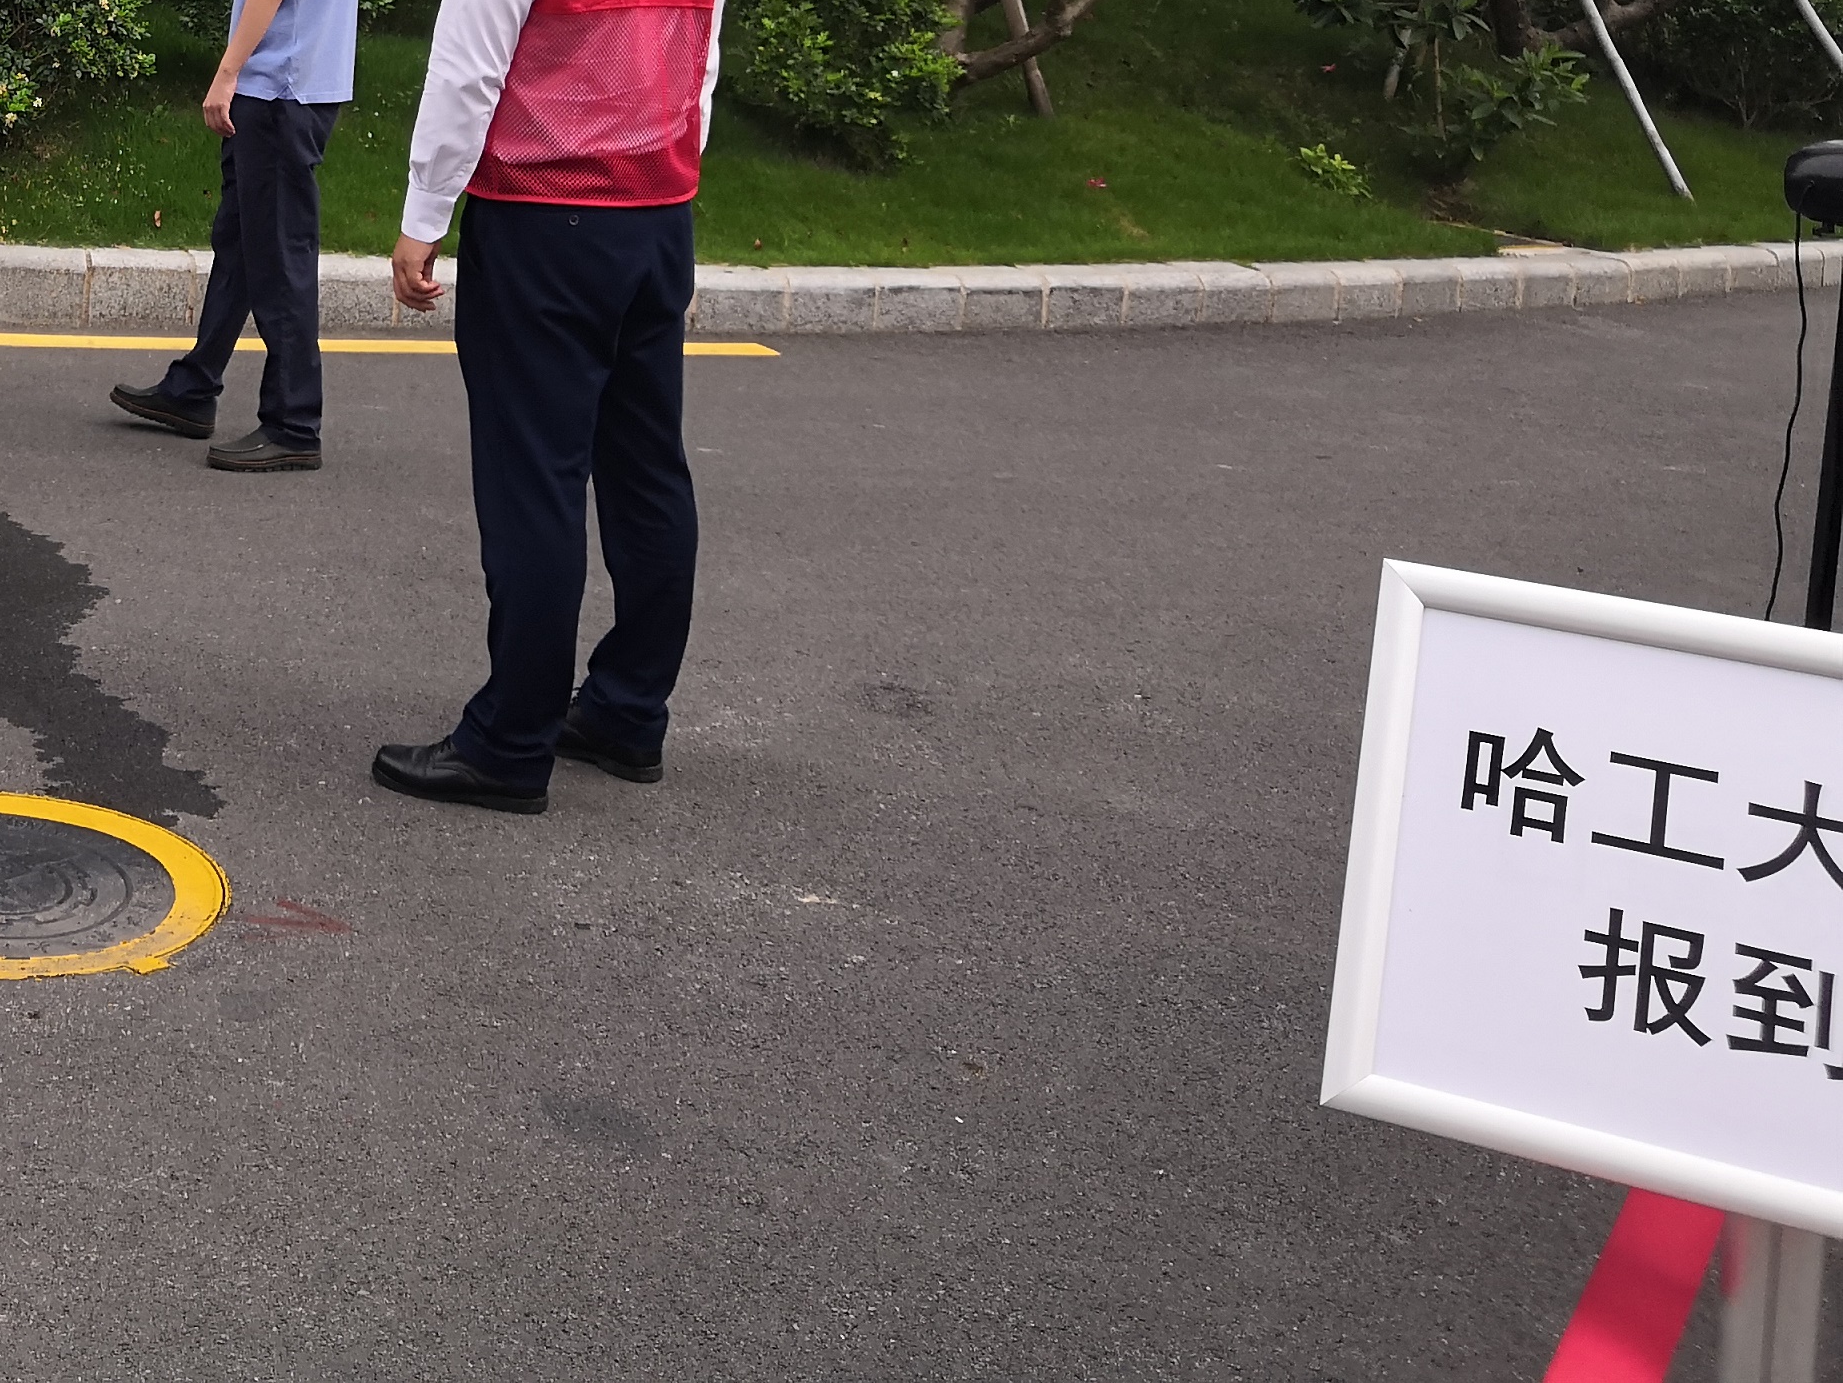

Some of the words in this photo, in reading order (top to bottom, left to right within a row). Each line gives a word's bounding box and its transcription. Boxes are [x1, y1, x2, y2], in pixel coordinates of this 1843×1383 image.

[1460, 727, 1843, 890] 哈工大
[1578, 908, 1843, 1081] 报到
